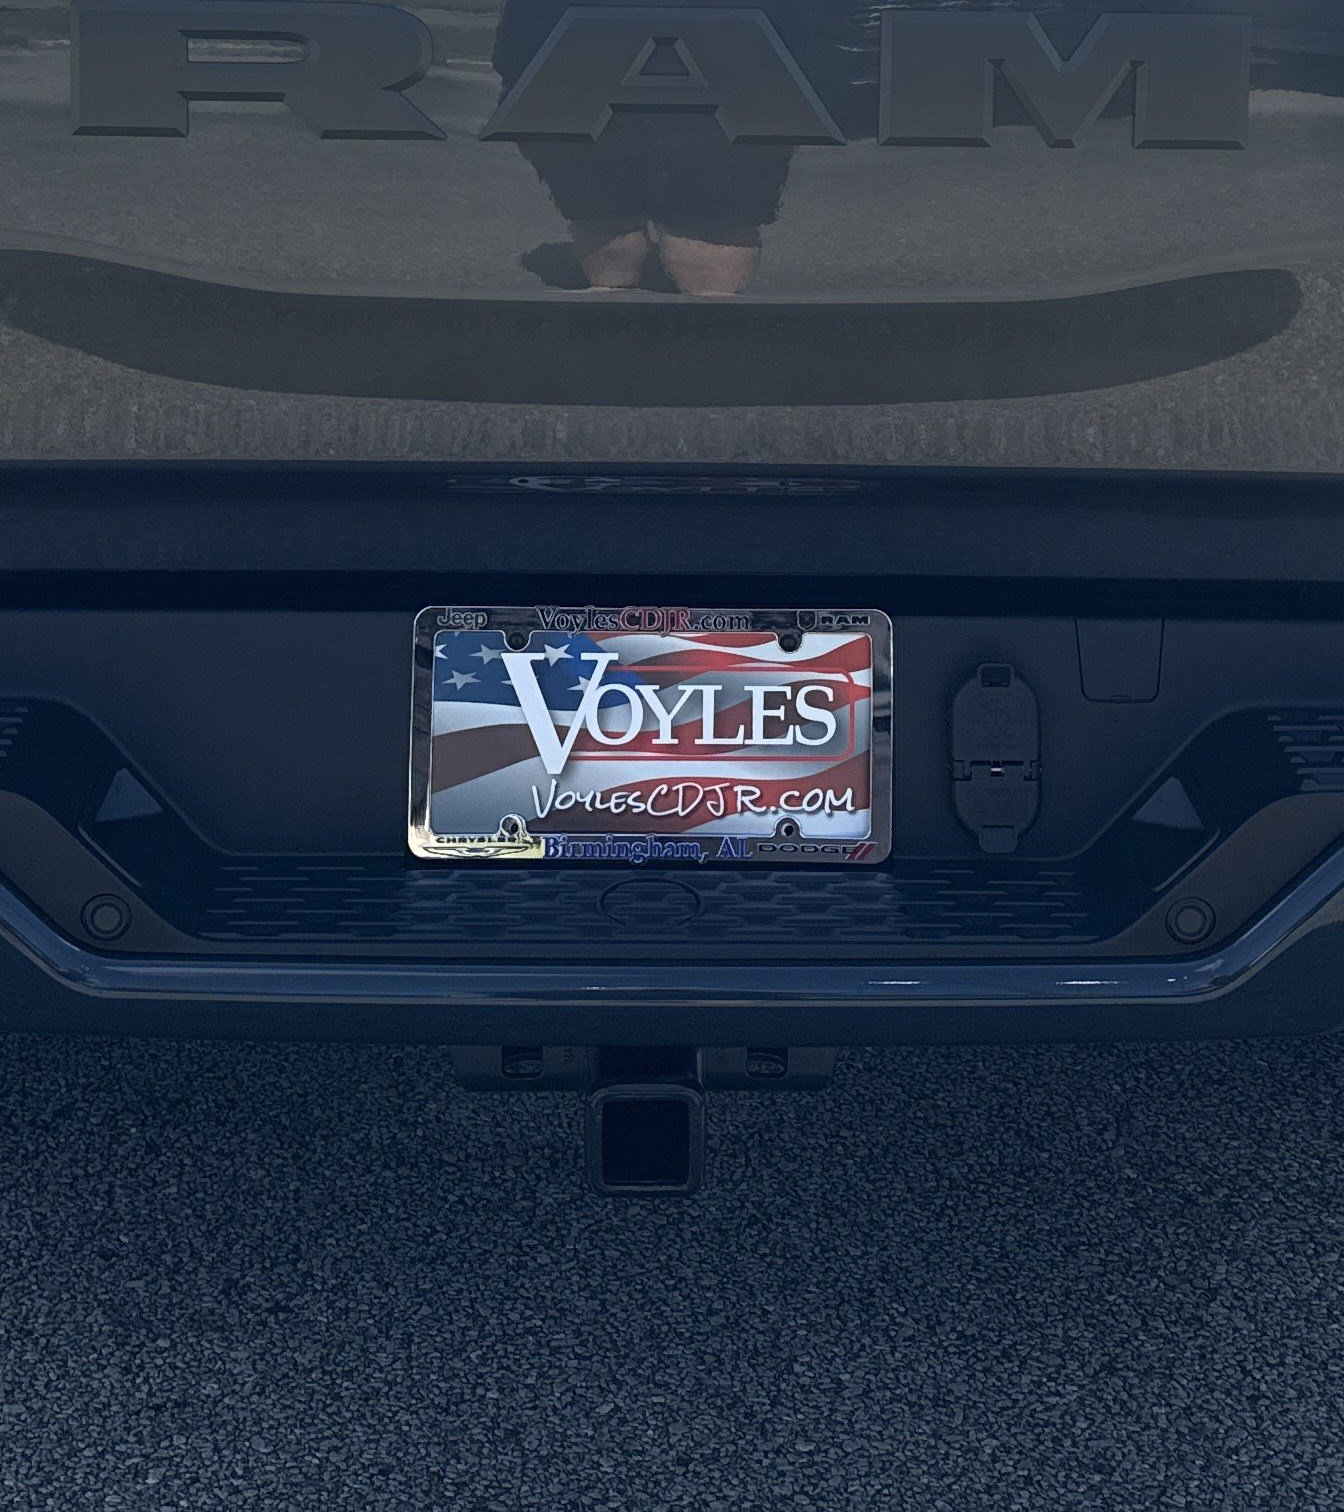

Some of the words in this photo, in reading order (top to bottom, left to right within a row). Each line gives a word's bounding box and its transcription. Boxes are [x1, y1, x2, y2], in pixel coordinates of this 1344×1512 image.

[436, 608, 487, 629] Jeep
[536, 604, 753, 638] VoylesCDJR.com
[820, 615, 870, 626] RAM
[544, 834, 708, 865] Birmingham,
[716, 835, 754, 859] AL
